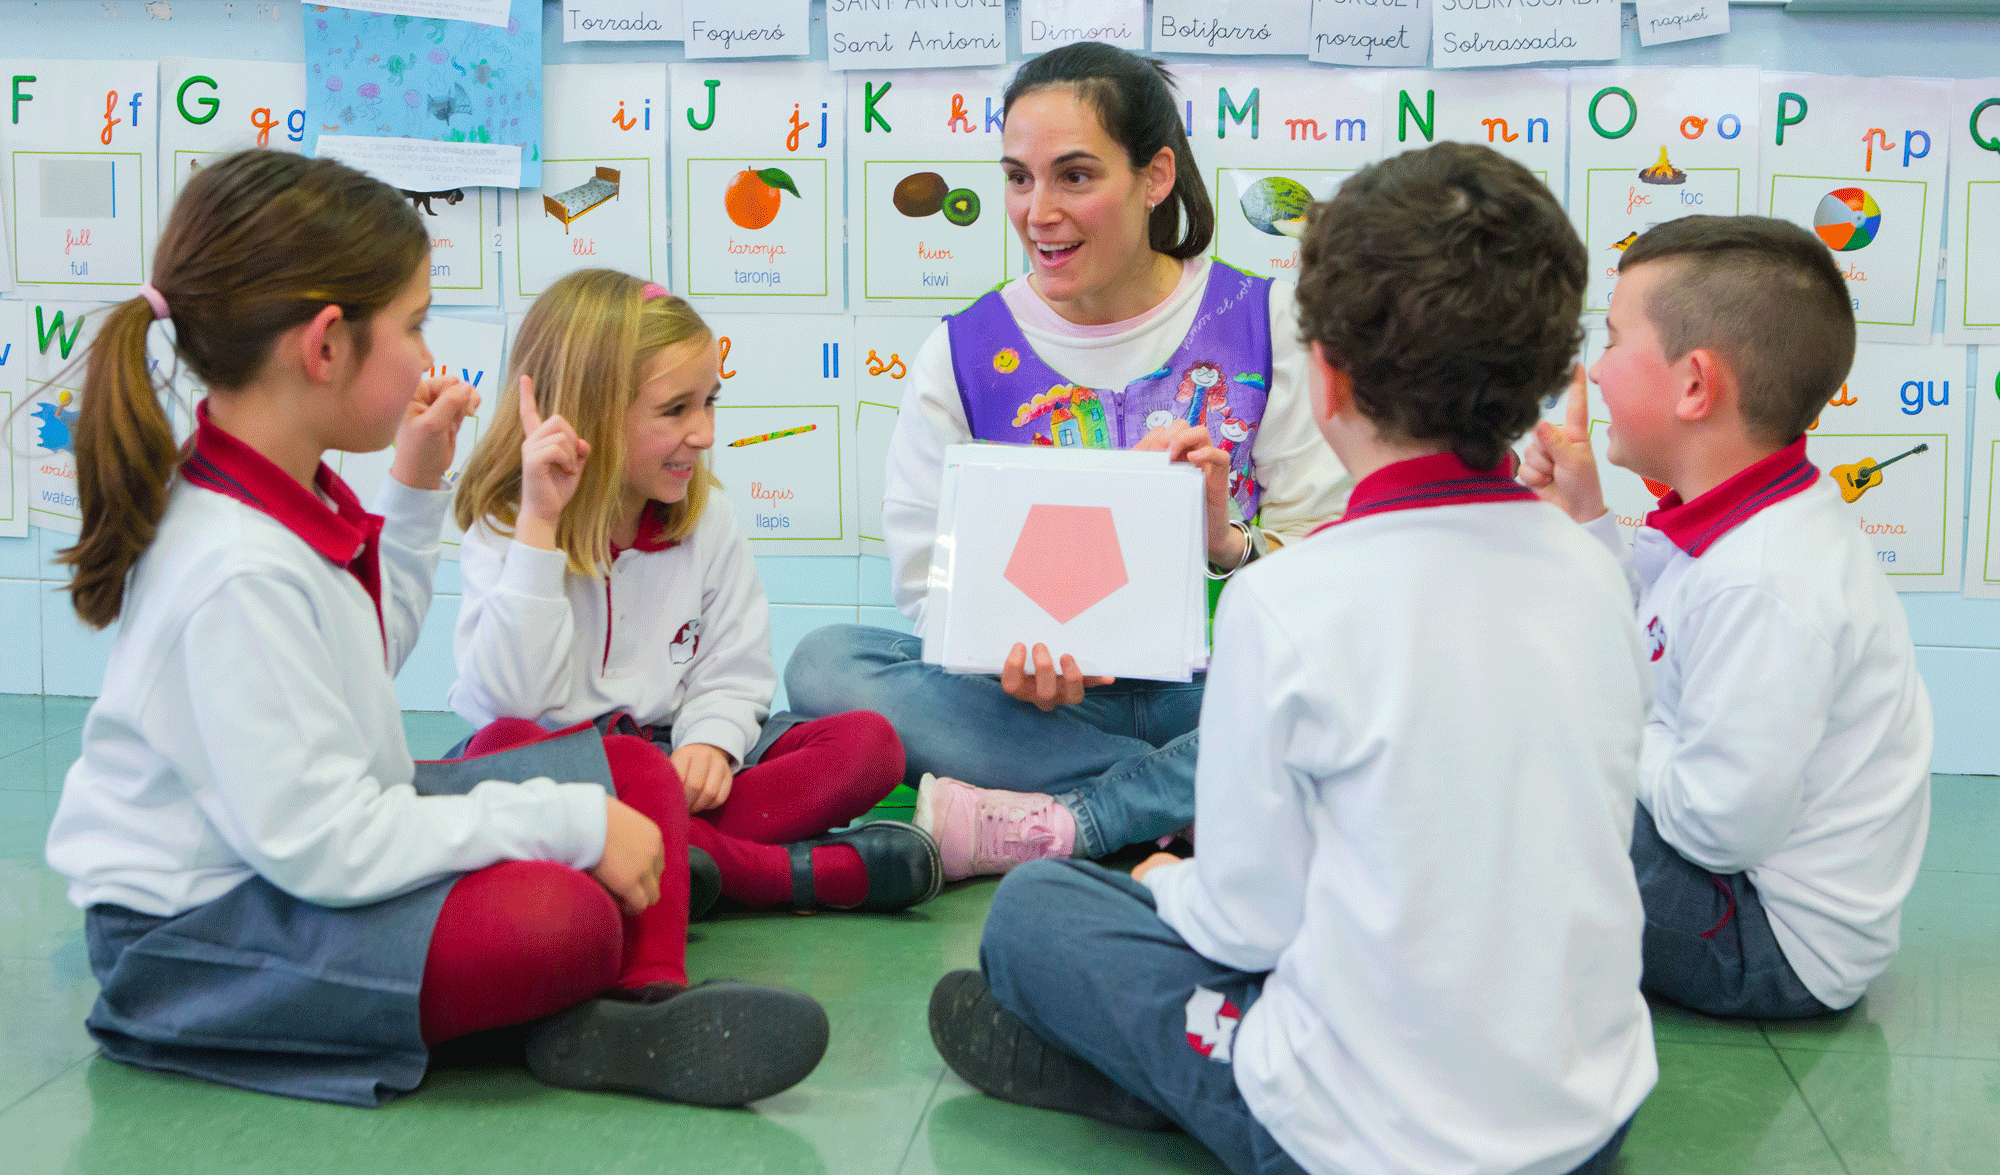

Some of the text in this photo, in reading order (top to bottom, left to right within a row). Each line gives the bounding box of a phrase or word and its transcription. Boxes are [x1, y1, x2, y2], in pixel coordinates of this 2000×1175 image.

[569, 10, 662, 31] Torrada
[1030, 20, 1133, 43] Dimoni
[1161, 16, 1271, 47] Botifarró
[1650, 7, 1707, 32] paquet
[693, 21, 785, 50] Fogueró
[834, 31, 1000, 53] Sant Antoni
[1316, 25, 1409, 60] porquet
[1444, 29, 1577, 53] Sobrassada
[12, 75, 37, 124] F
[129, 93, 142, 127] f
[177, 76, 220, 125] G
[288, 110, 306, 142] g
[645, 99, 650, 130] i
[865, 82, 892, 133] K
[1218, 87, 1366, 141] M m m
[1588, 87, 1741, 140] O o o
[687, 80, 827, 152] J j j
[1399, 90, 1548, 143] N n n
[1776, 92, 1931, 172] P p p
[1627, 187, 1652, 214] foc
[1681, 189, 1703, 206] foc
[65, 229, 91, 255] full
[573, 238, 596, 255] llit
[728, 238, 786, 264] taronja
[918, 242, 953, 259] kiwi
[71, 261, 88, 275] full
[734, 270, 780, 286] taronja
[923, 272, 948, 286] kiwi
[35, 305, 86, 361] W
[866, 350, 906, 379] ss
[1900, 381, 1949, 415] gu
[751, 482, 793, 508] llapis
[756, 514, 790, 530] llapis
